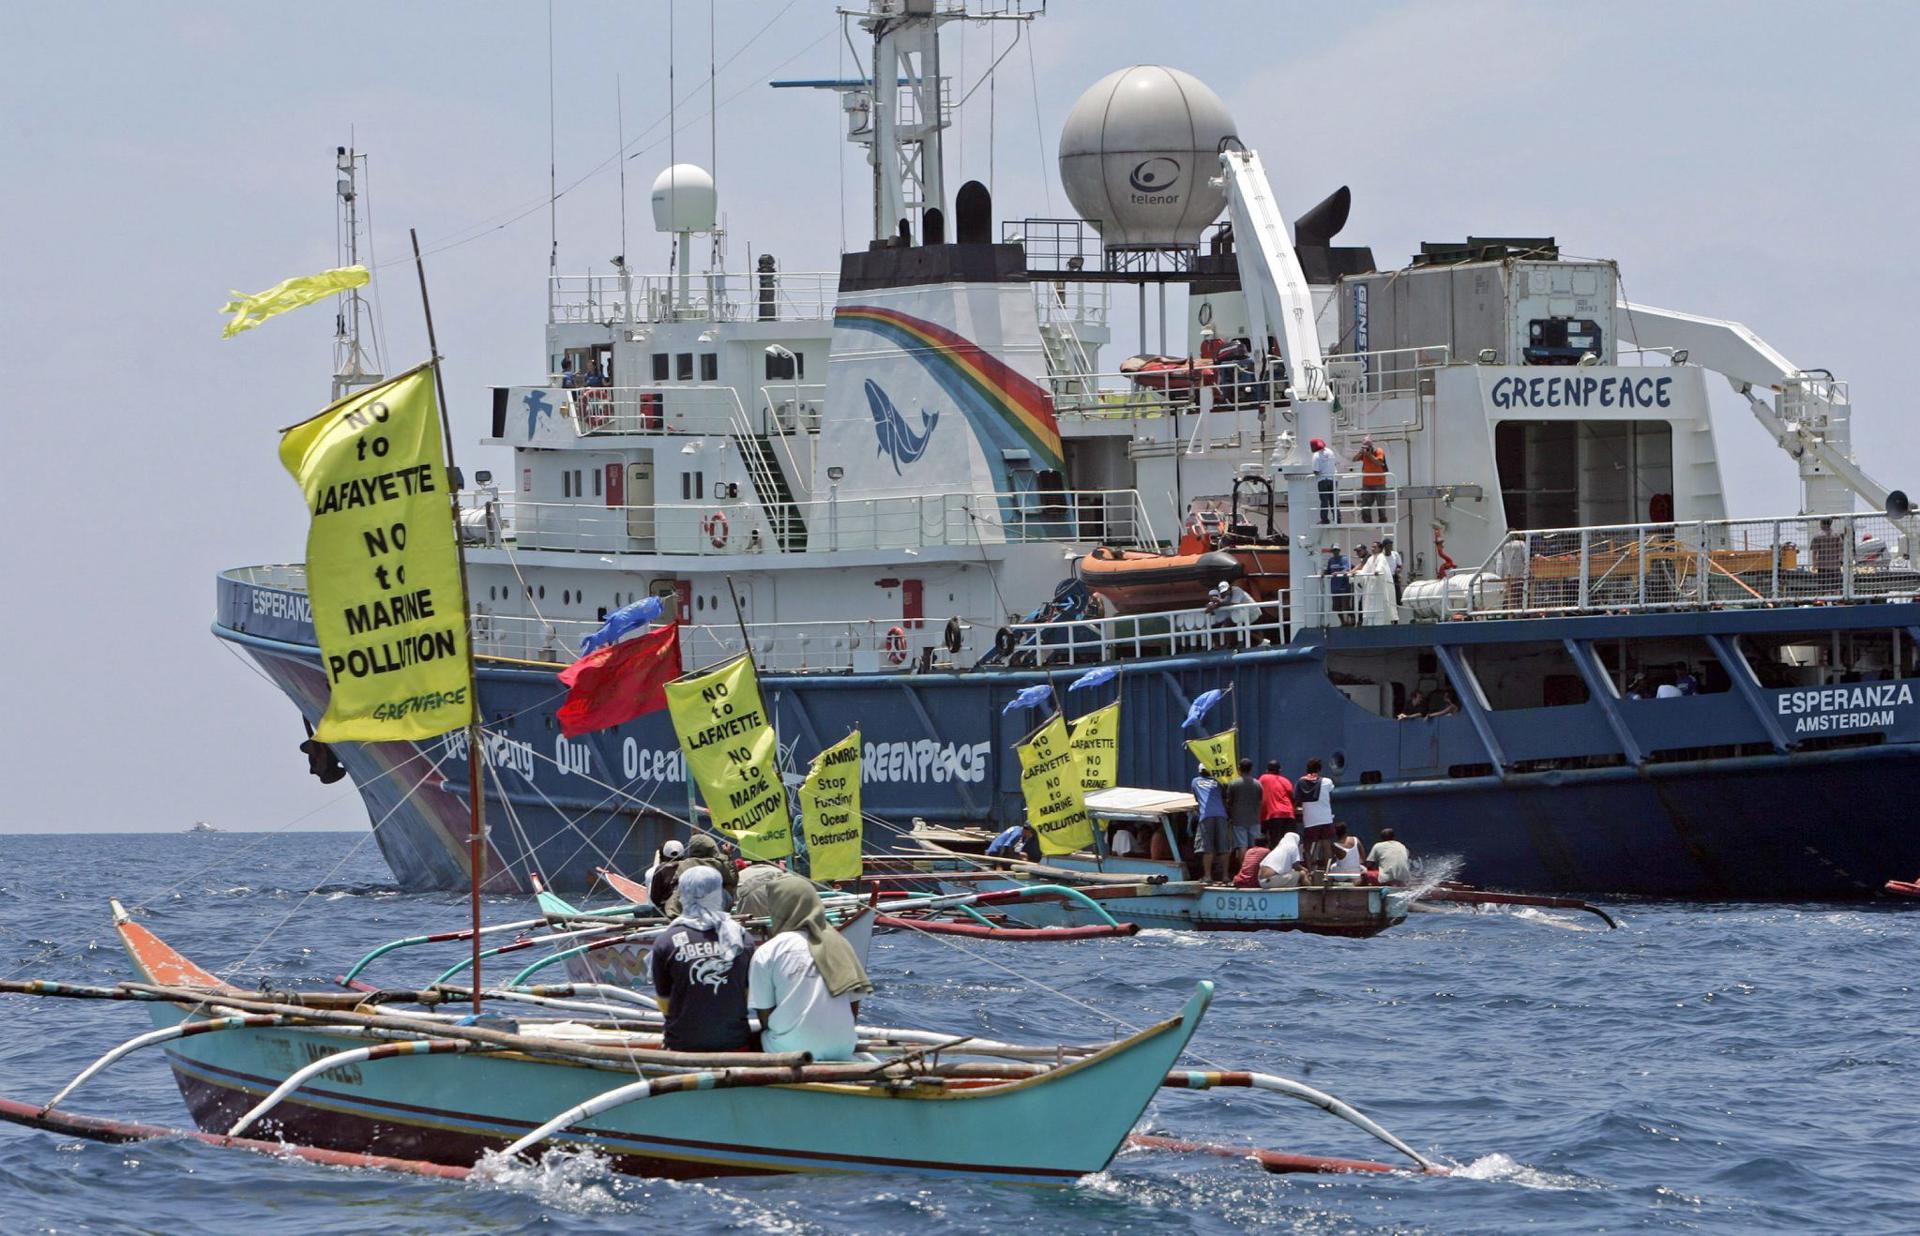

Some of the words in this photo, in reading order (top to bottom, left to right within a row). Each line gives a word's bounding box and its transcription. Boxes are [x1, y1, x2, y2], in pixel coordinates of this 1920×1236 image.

[1131, 194, 1180, 205] telenor
[1491, 376, 1673, 410] GREENPEACE
[344, 401, 389, 430] NO
[356, 436, 389, 461] to
[315, 463, 436, 517] LAFAYETTE
[363, 522, 407, 558] NO
[374, 564, 406, 590] to
[344, 589, 435, 636] MARINE
[328, 629, 457, 685] POLLUTION
[702, 682, 728, 703] NO
[1778, 684, 1914, 715] ESPERANZA
[711, 703, 734, 720] to
[1795, 710, 1895, 733] AMSTERDAM
[687, 711, 762, 751] LAFAYETTE
[1086, 728, 1098, 736] to
[1032, 735, 1049, 750] NO
[1071, 739, 1115, 750] LAFAYETTE
[1210, 743, 1222, 754] NO
[555, 733, 591, 775] Our
[727, 747, 752, 765] NO
[860, 739, 992, 787] REENPEACE
[1038, 749, 1052, 760] to
[1086, 755, 1101, 766] NO
[739, 766, 760, 782] to
[1023, 752, 1071, 780] LAFAYETTE
[1086, 768, 1099, 777] to
[818, 777, 846, 791] Stop
[1046, 776, 1060, 790] NO
[1049, 791, 1062, 801] to
[1039, 796, 1073, 817] MARINE
[820, 812, 849, 827] Ocean
[1037, 810, 1087, 834] POLLUTION
[810, 828, 860, 847] Destruction
[1216, 896, 1268, 912] OSIAO
